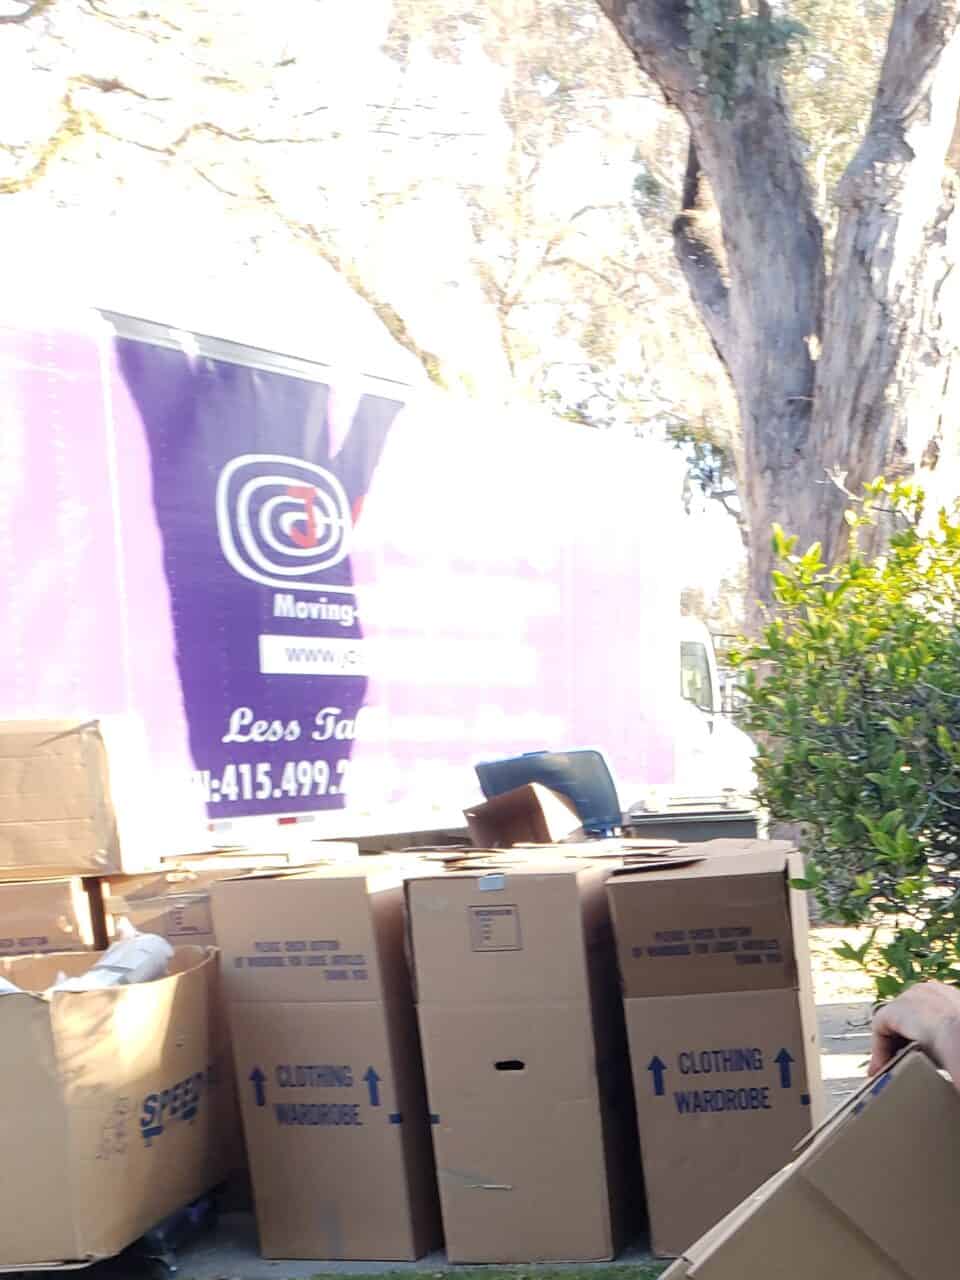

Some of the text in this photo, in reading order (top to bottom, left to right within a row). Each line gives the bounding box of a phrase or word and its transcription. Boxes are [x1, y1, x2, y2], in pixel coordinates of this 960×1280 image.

[221, 706, 358, 743] Less Ta
[678, 1047, 764, 1075] CLOTHING
[276, 1064, 353, 1089] CLOTHING
[673, 1086, 773, 1115] WARDROBE
[276, 1103, 364, 1127] WARDROBE
